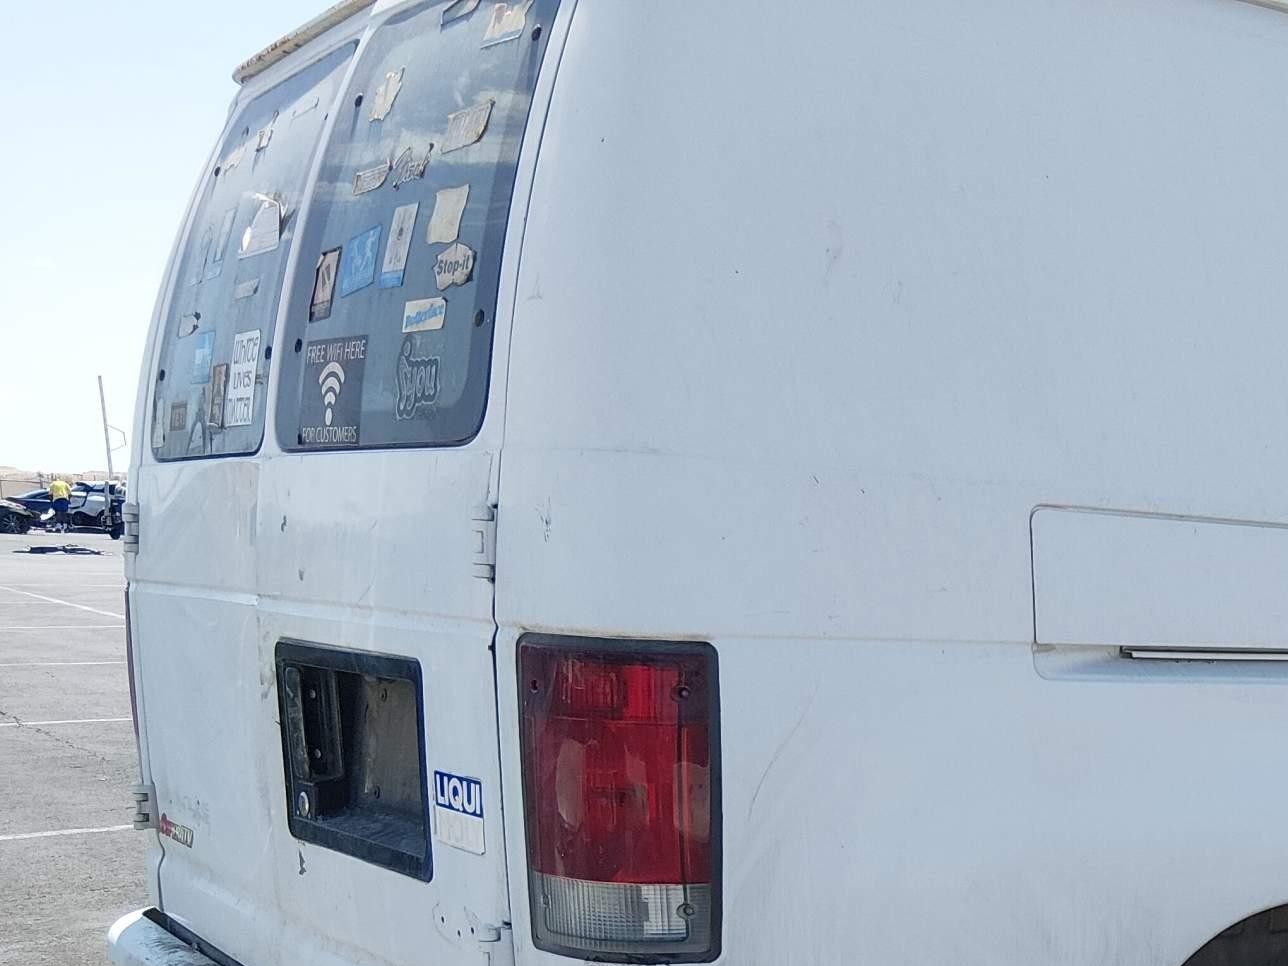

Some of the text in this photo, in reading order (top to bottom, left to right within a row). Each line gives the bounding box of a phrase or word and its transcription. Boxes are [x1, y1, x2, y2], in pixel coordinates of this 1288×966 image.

[306, 344, 326, 364] FREE
[344, 340, 366, 360] HERE
[302, 426, 357, 443] FOR CUSTOMERS
[436, 773, 481, 815] LIQUI
